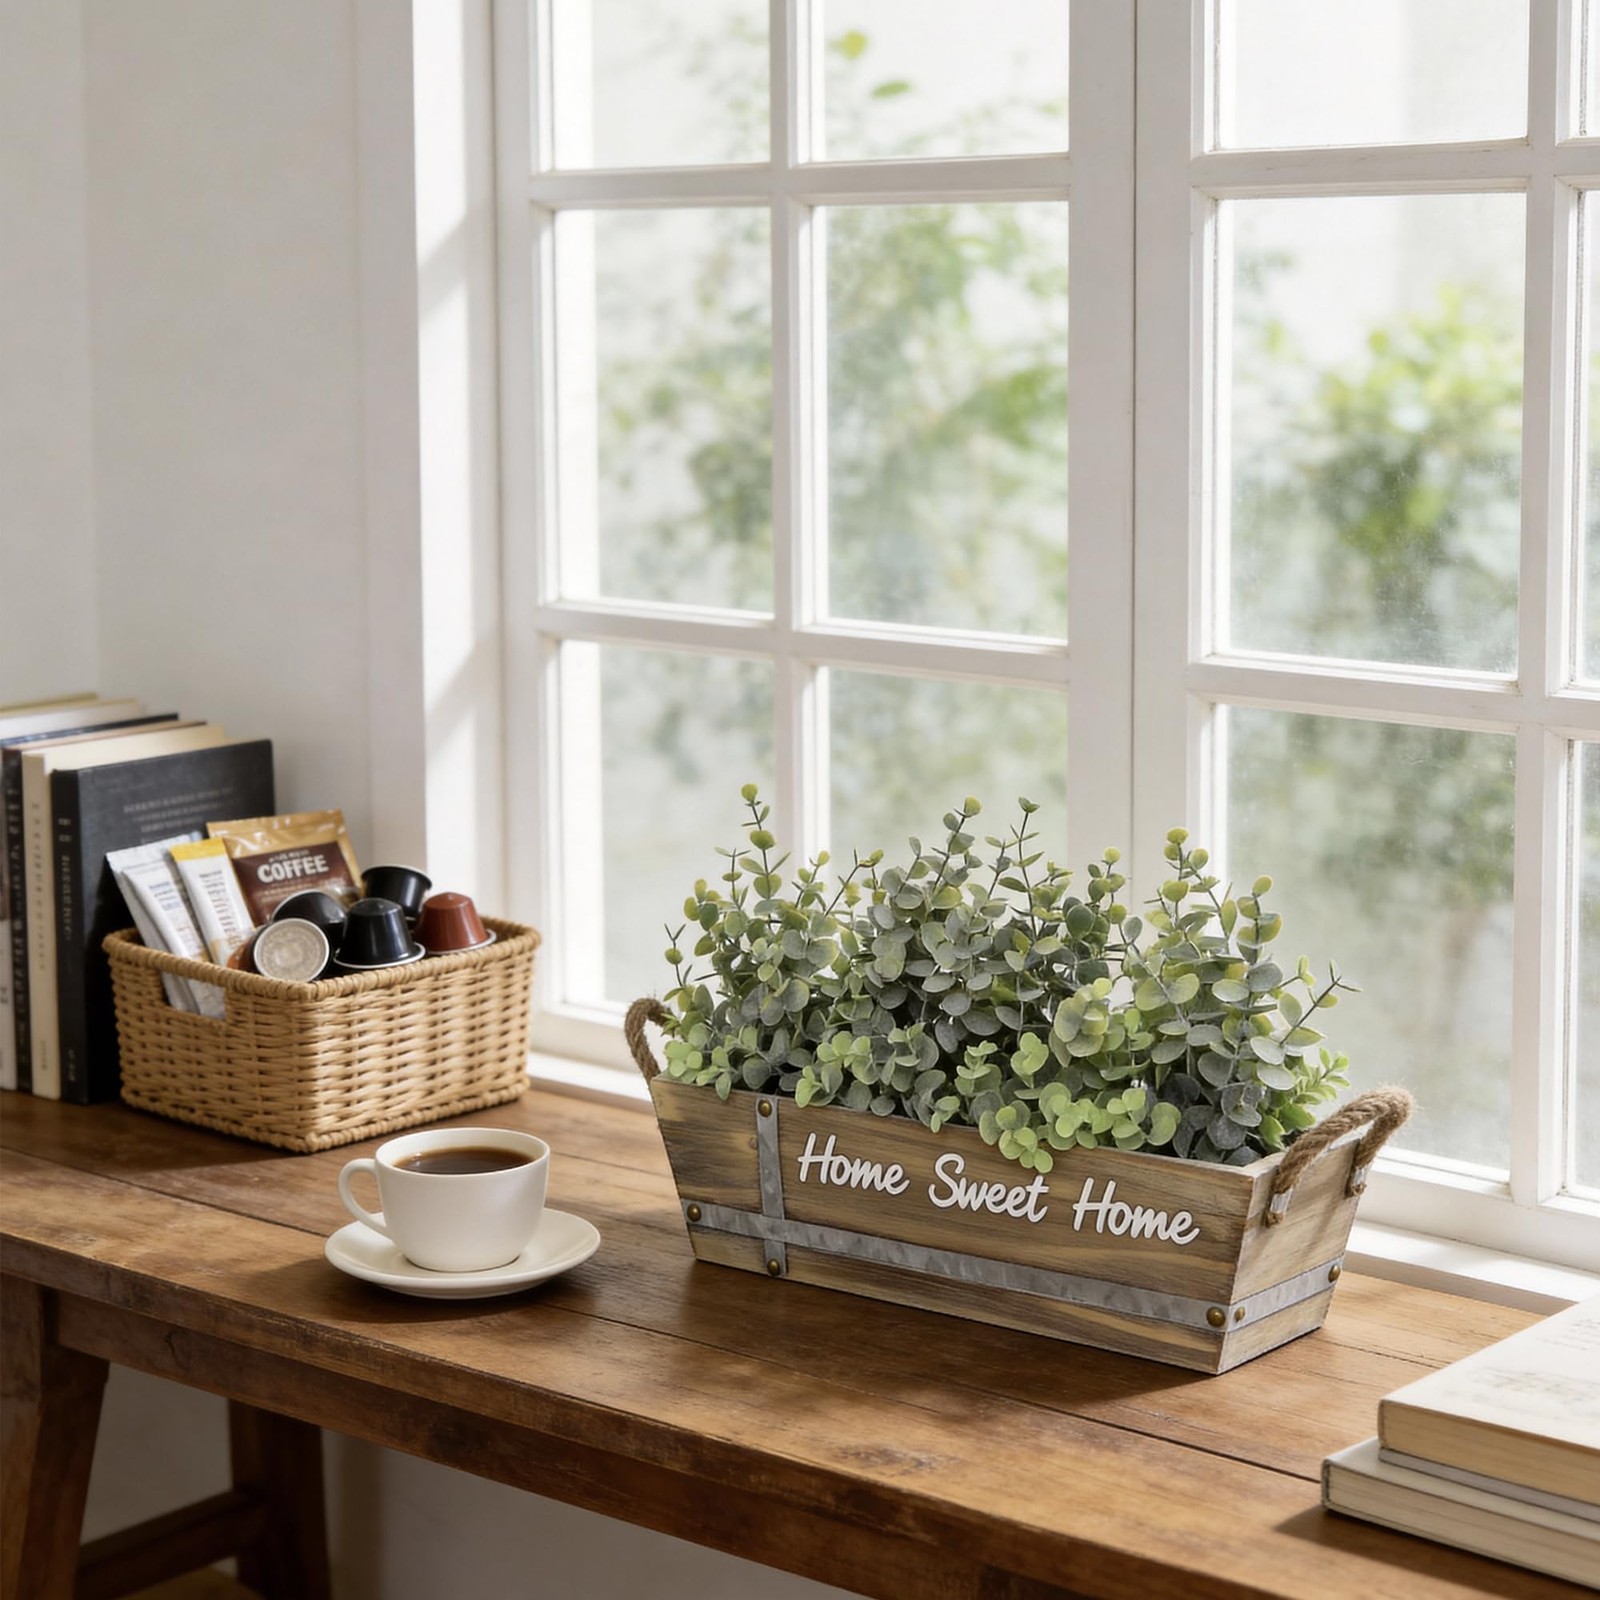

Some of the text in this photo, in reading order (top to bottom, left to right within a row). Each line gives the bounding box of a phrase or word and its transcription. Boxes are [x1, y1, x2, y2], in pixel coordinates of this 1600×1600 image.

[257, 854, 330, 884] COFFEE
[798, 1132, 1200, 1245] Home Sweet Home
